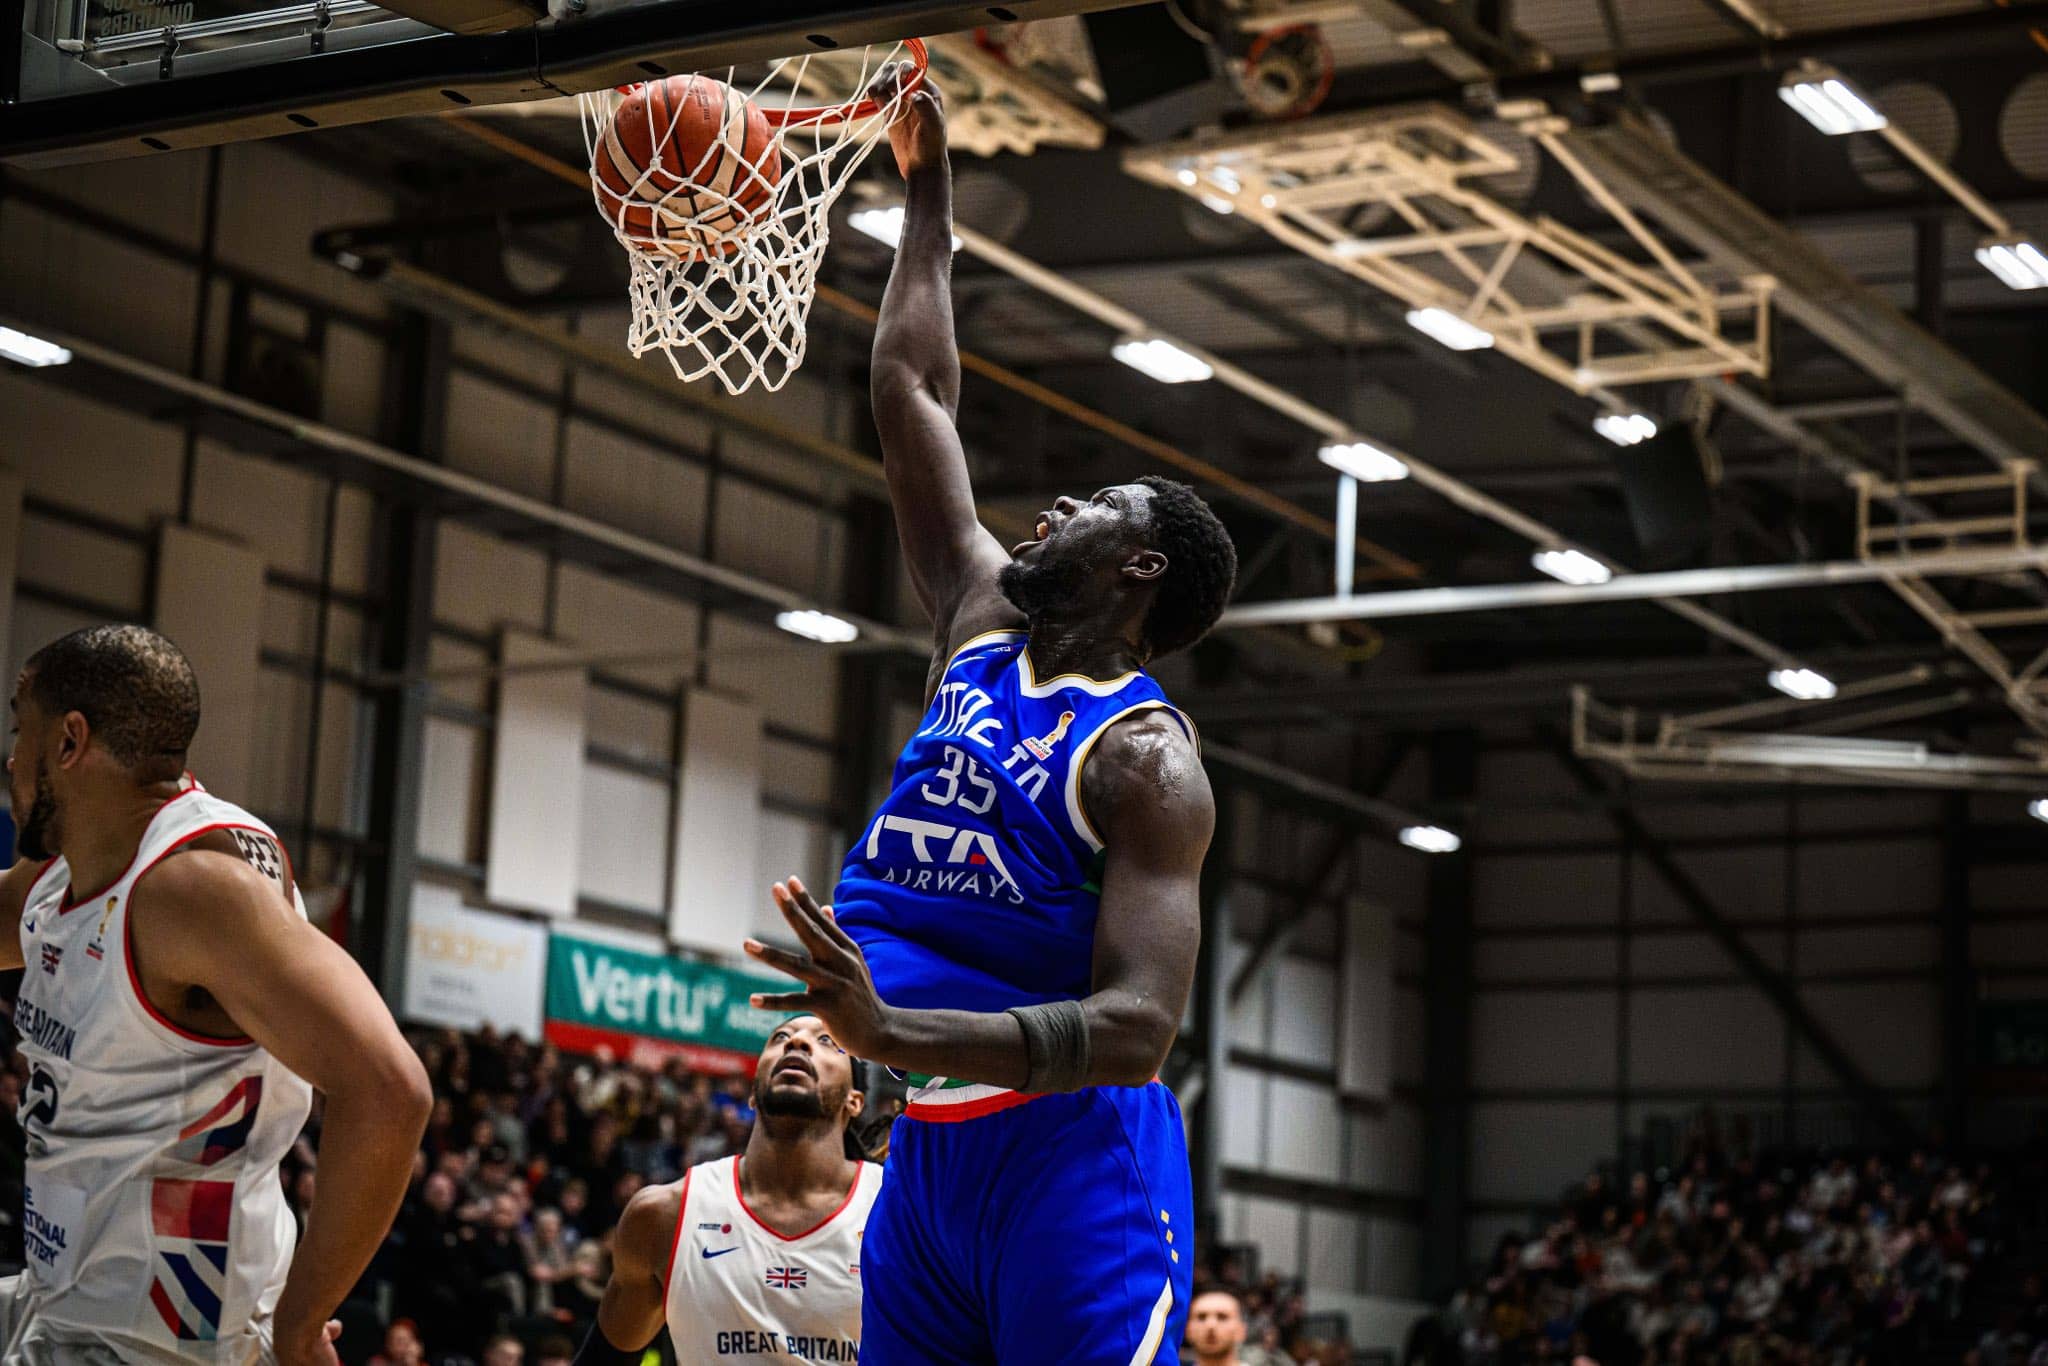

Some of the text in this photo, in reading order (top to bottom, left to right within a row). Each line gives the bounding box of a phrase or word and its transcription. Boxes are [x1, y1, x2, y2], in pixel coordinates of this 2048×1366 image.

[921, 745, 997, 814] 35
[866, 814, 1020, 890] ITA
[880, 867, 1025, 904] AIRWAYS
[571, 948, 707, 1034] Vertu
[717, 1331, 859, 1362] GREAT BRITAIN
